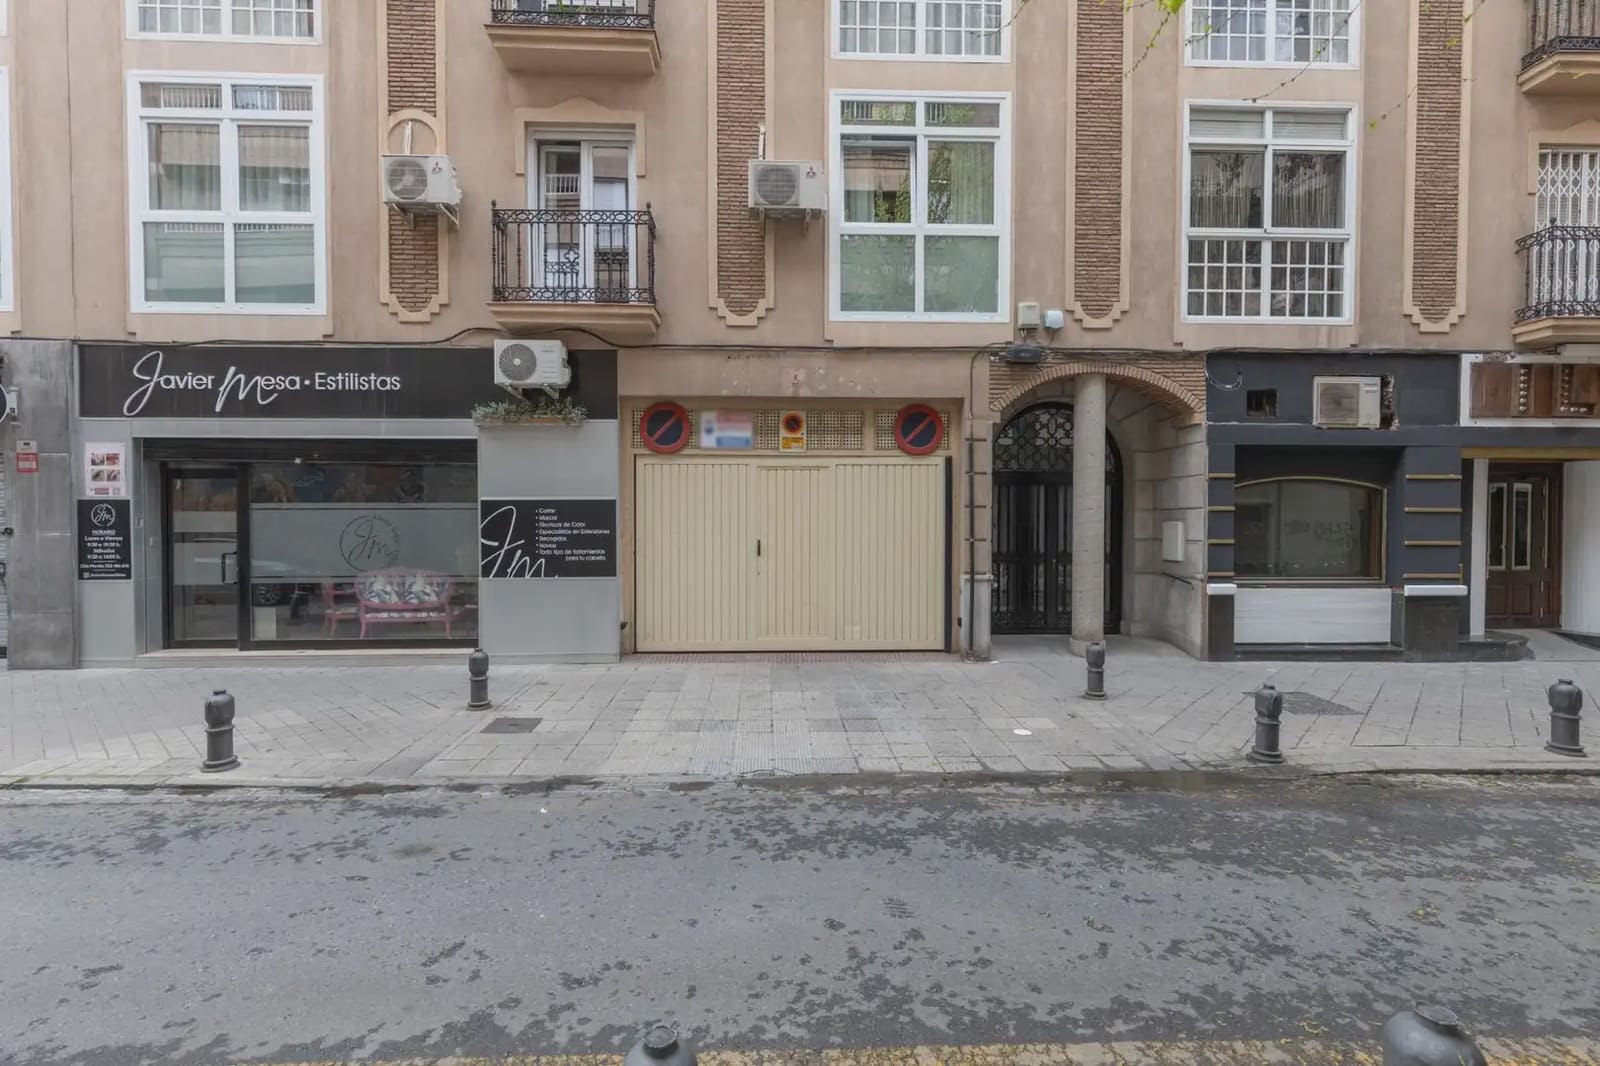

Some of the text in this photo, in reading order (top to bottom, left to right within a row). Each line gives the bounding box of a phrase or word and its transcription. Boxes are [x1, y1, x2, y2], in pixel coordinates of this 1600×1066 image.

[123, 350, 400, 416] Javier Mesa Estilistas
